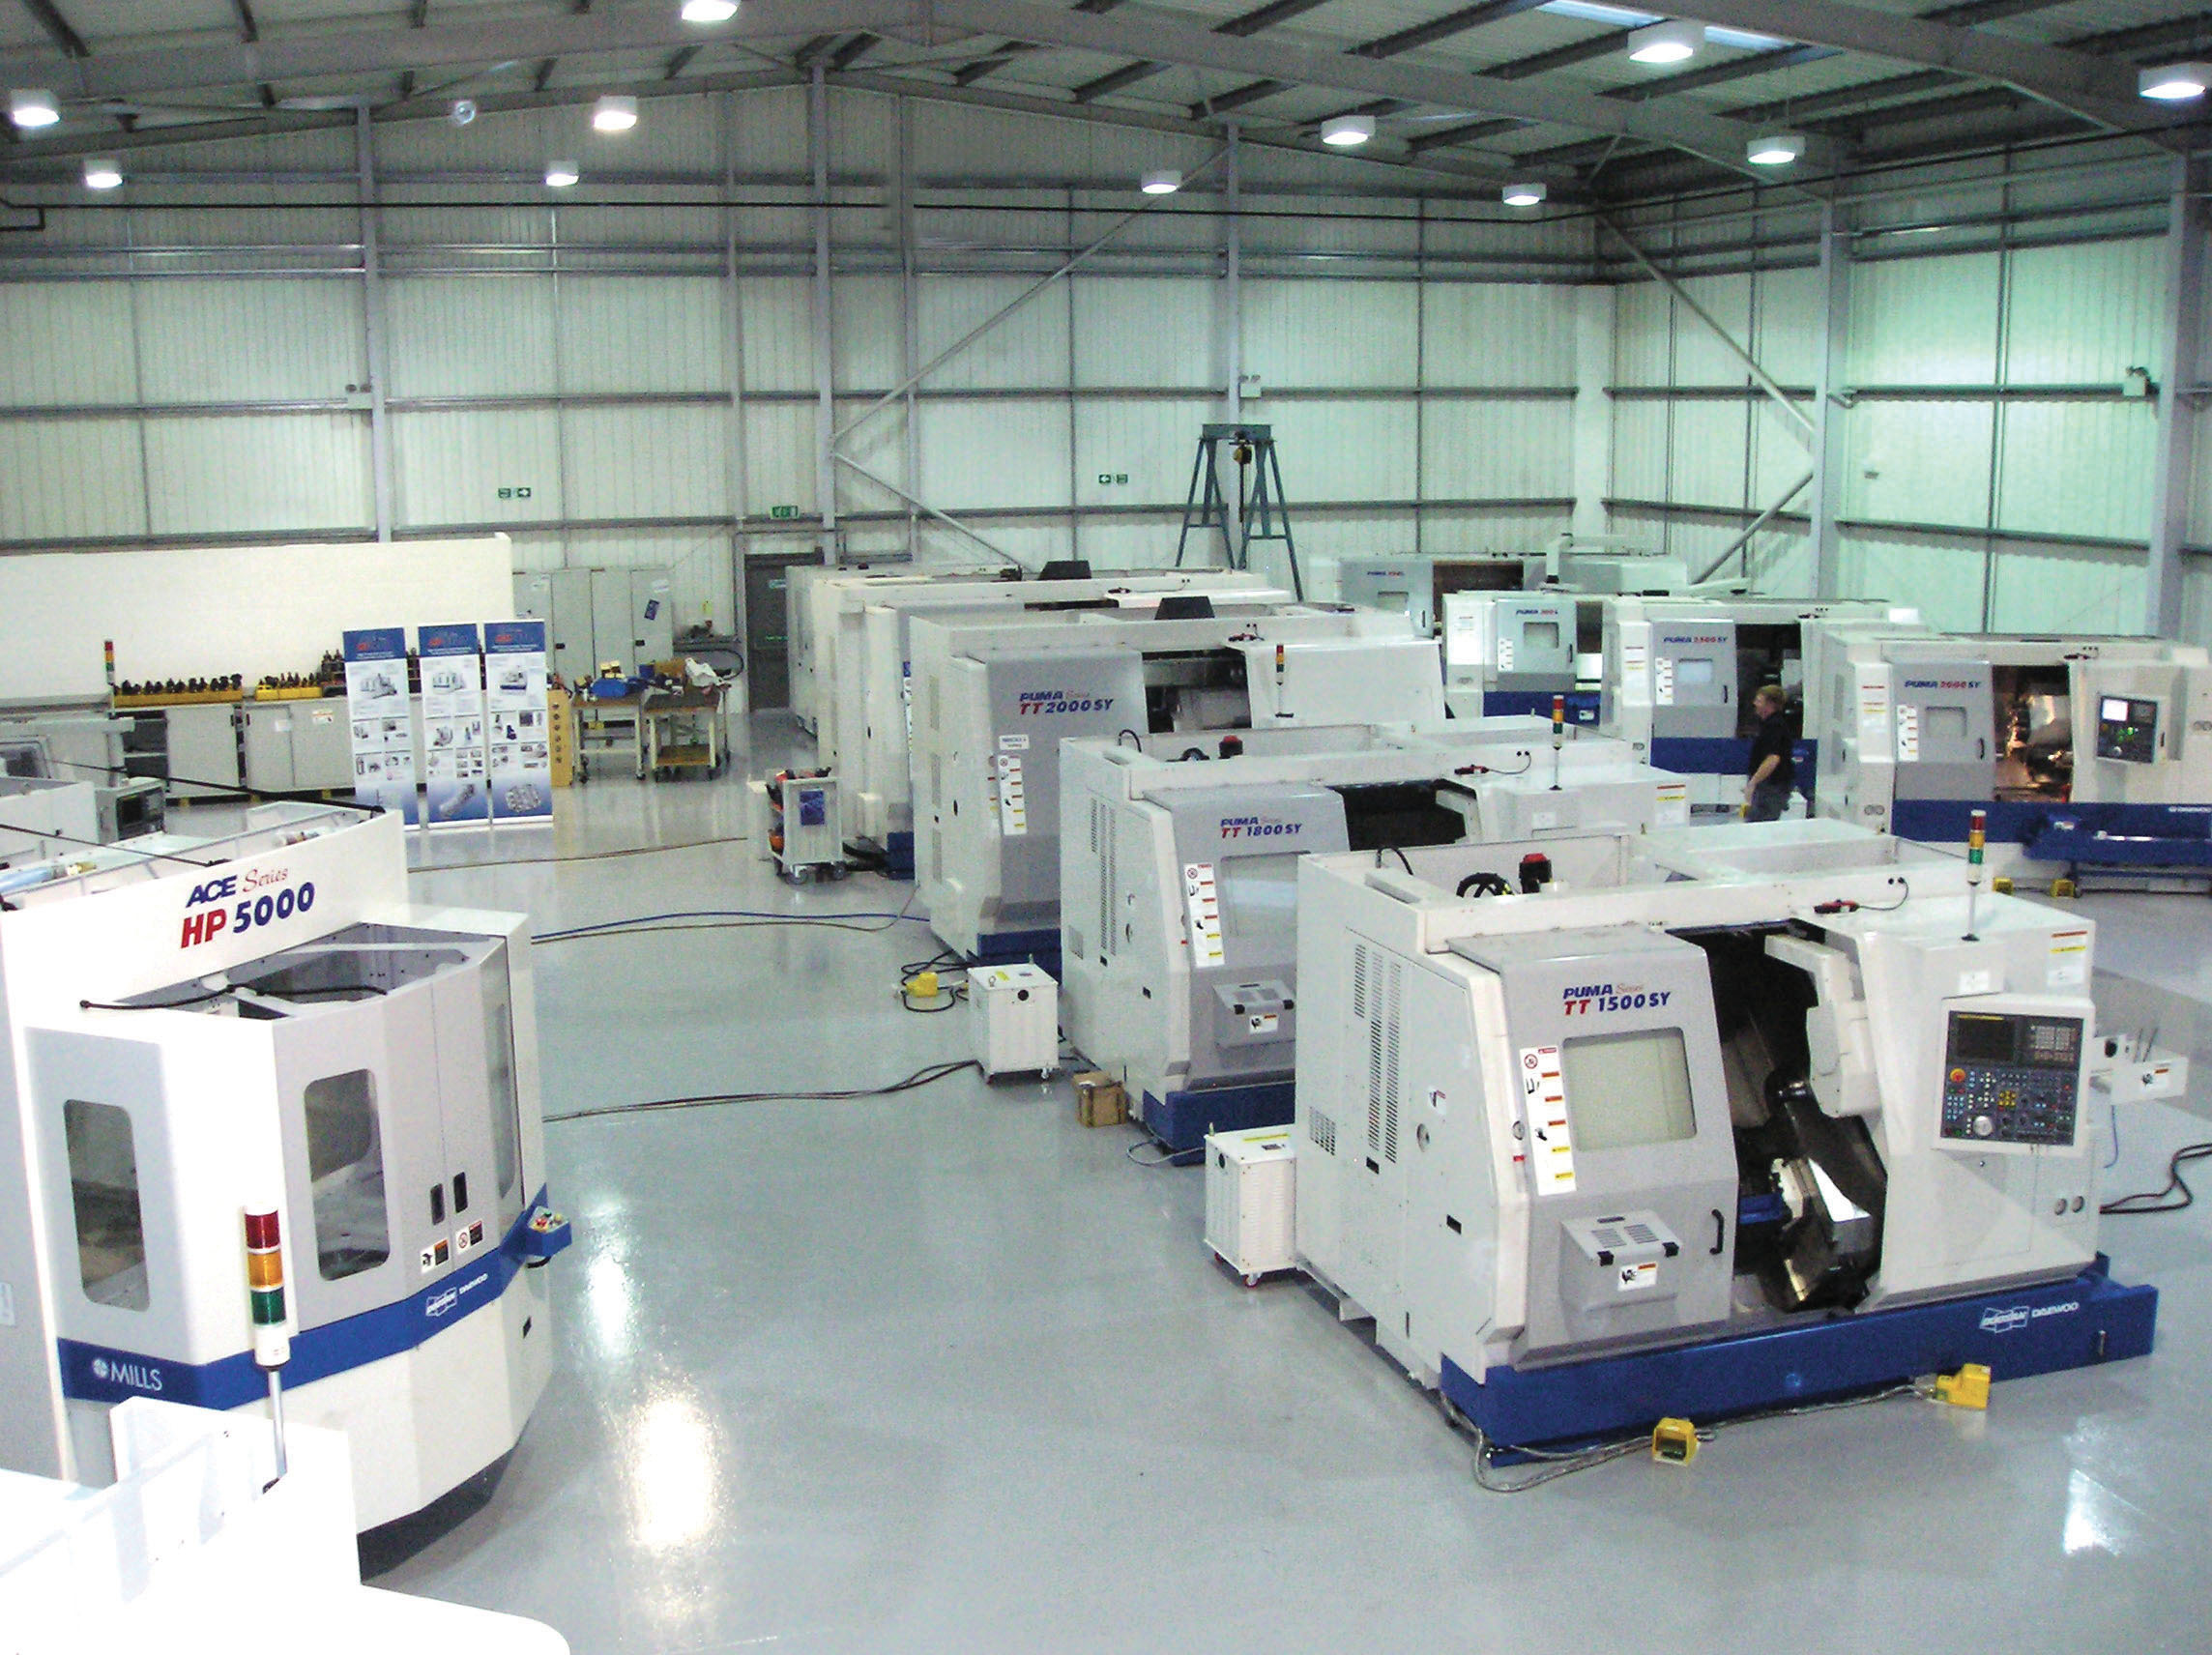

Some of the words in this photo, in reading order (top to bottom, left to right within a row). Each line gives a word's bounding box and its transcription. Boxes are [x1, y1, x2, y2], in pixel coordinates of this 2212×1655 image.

[1020, 690, 1063, 702] PUMA
[1021, 702, 1044, 715] TT
[1220, 817, 1259, 828] PUMA
[1221, 828, 1241, 839] TT
[186, 874, 238, 908] ACE
[243, 868, 289, 893] Series
[181, 908, 227, 949] HP
[233, 882, 315, 934] 5000
[1562, 984, 1614, 1000] PUMA
[1564, 999, 1591, 1015] TT
[110, 1360, 162, 1391] MILLS
